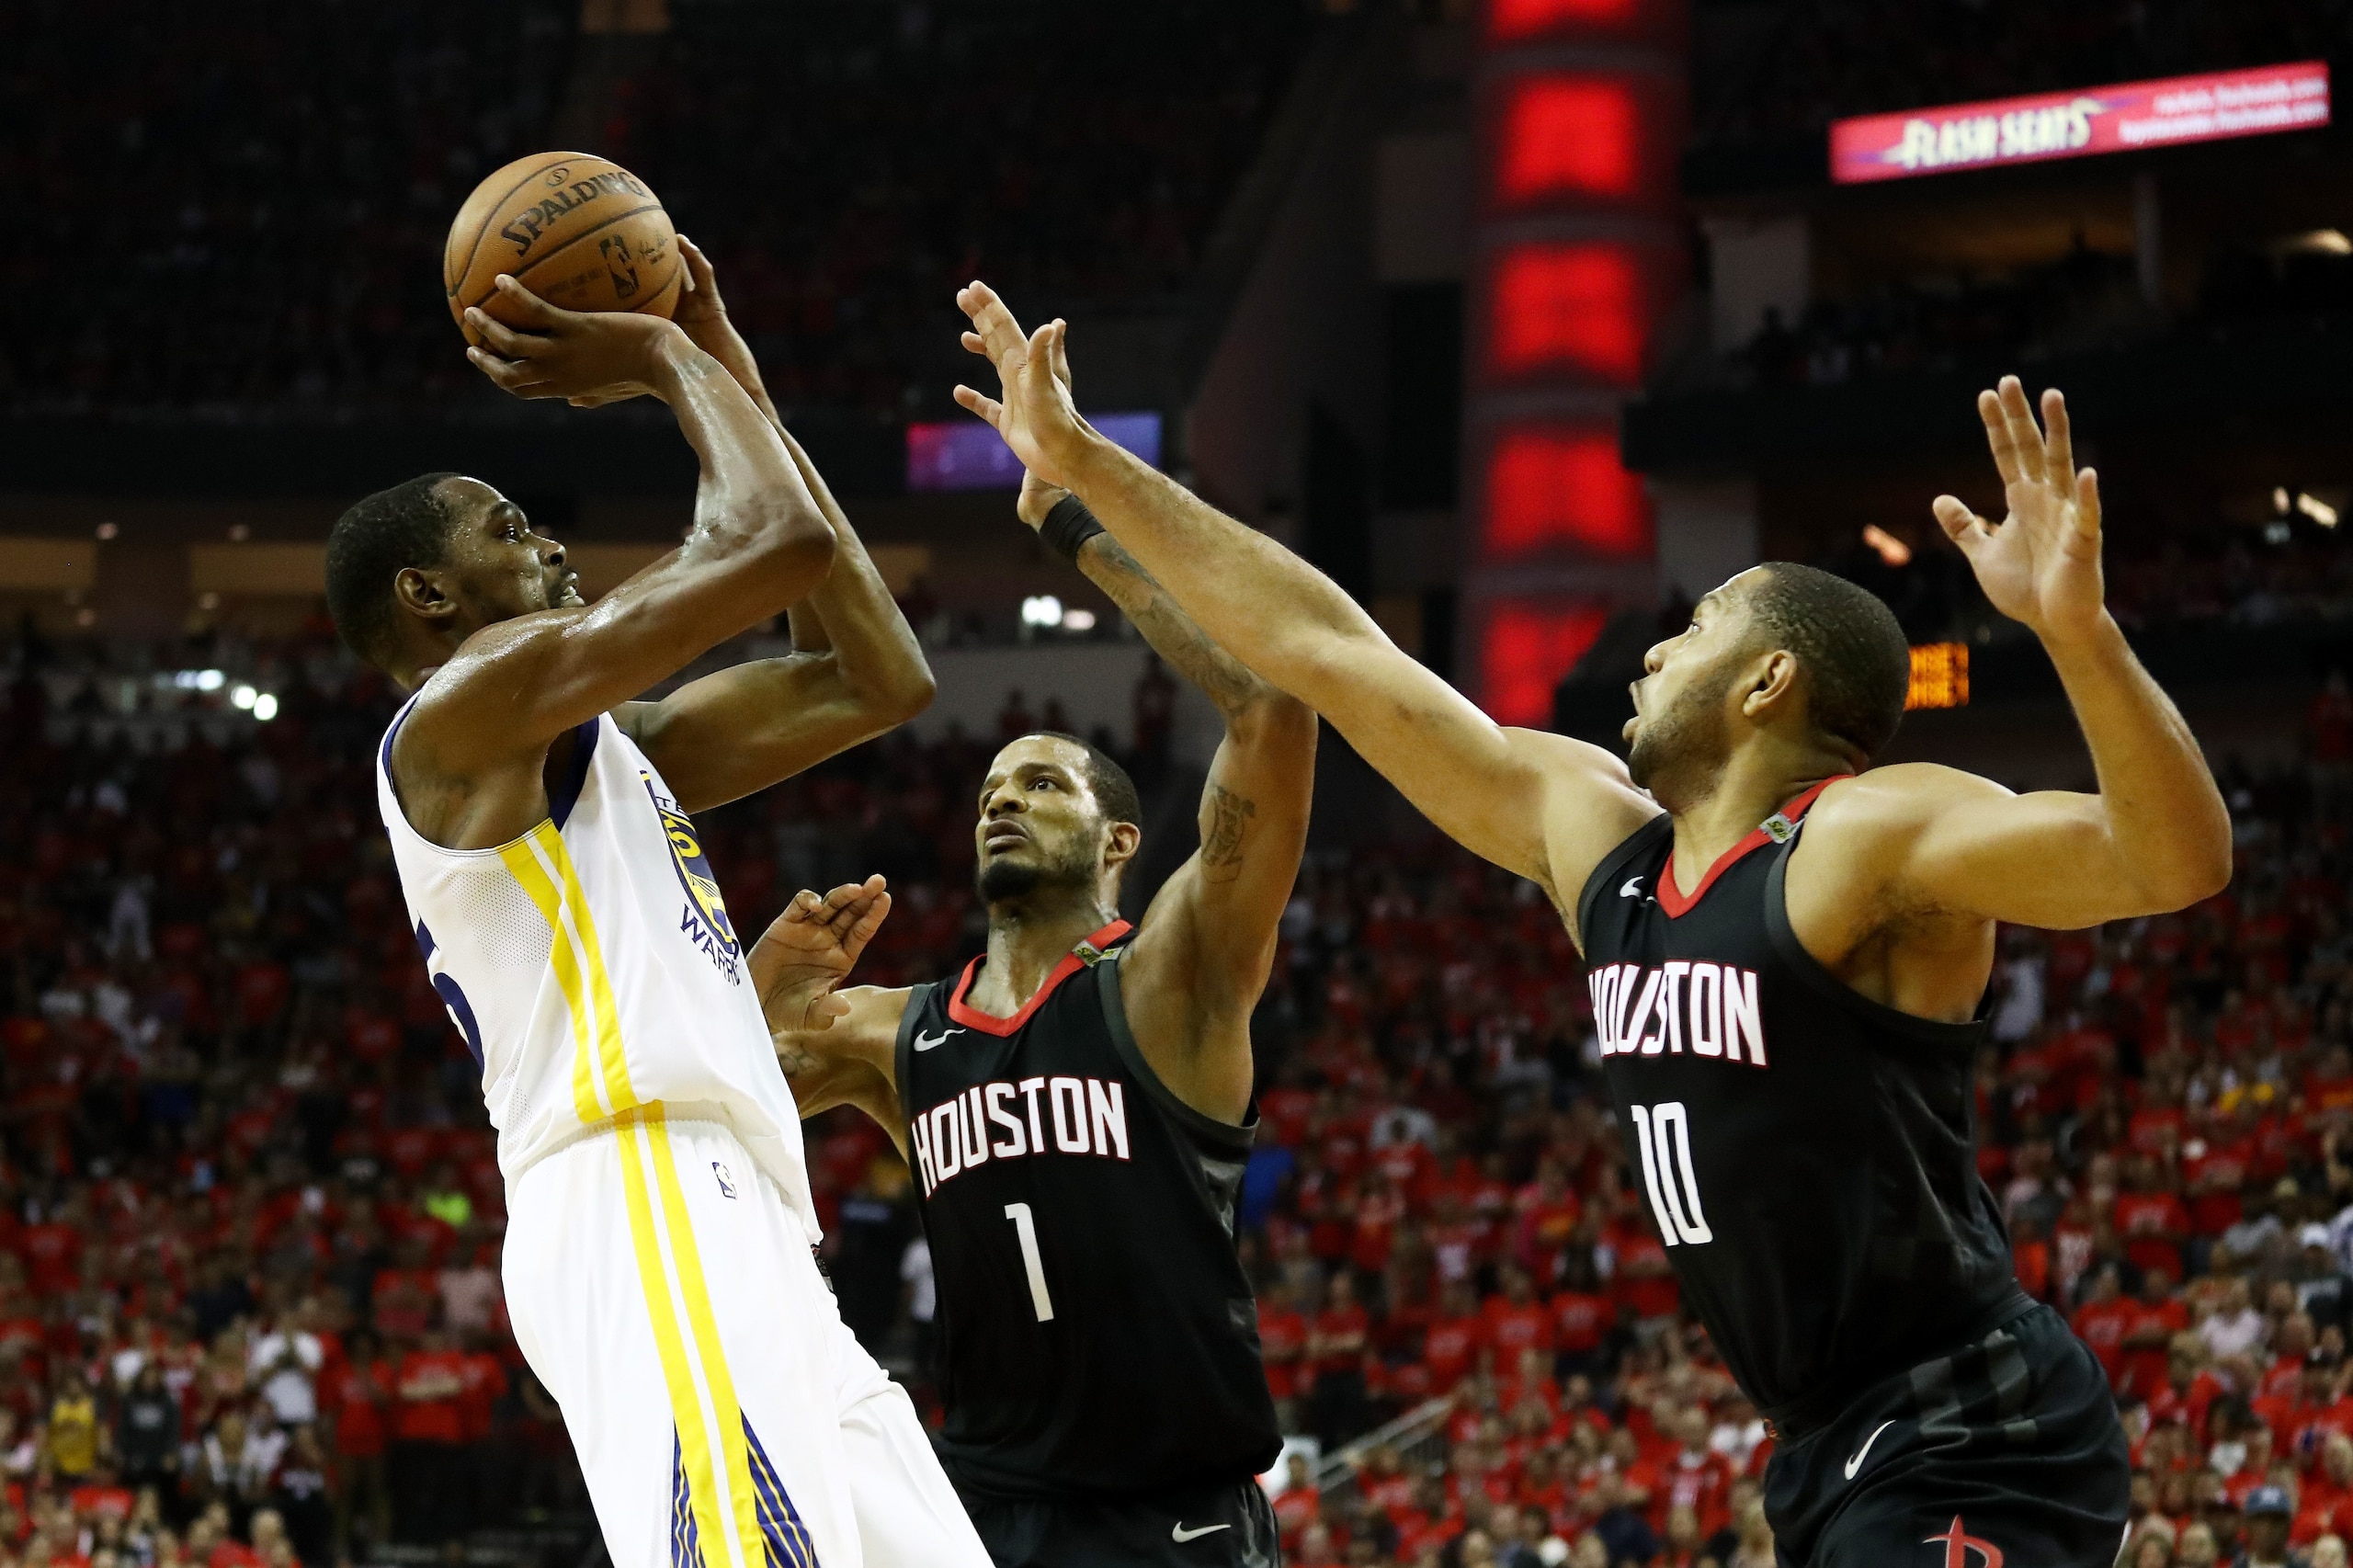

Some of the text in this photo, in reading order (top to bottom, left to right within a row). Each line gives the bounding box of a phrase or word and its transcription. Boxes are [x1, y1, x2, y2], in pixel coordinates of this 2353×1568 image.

[1894, 117, 1999, 169] FLASH
[2000, 97, 2102, 157] SEATS
[501, 171, 647, 256] SPALDING
[1588, 960, 1769, 1070] HOUSTON
[911, 1074, 1131, 1200] HOUSTON
[1631, 1101, 1714, 1248] 10
[1004, 1202, 1055, 1324] 1
